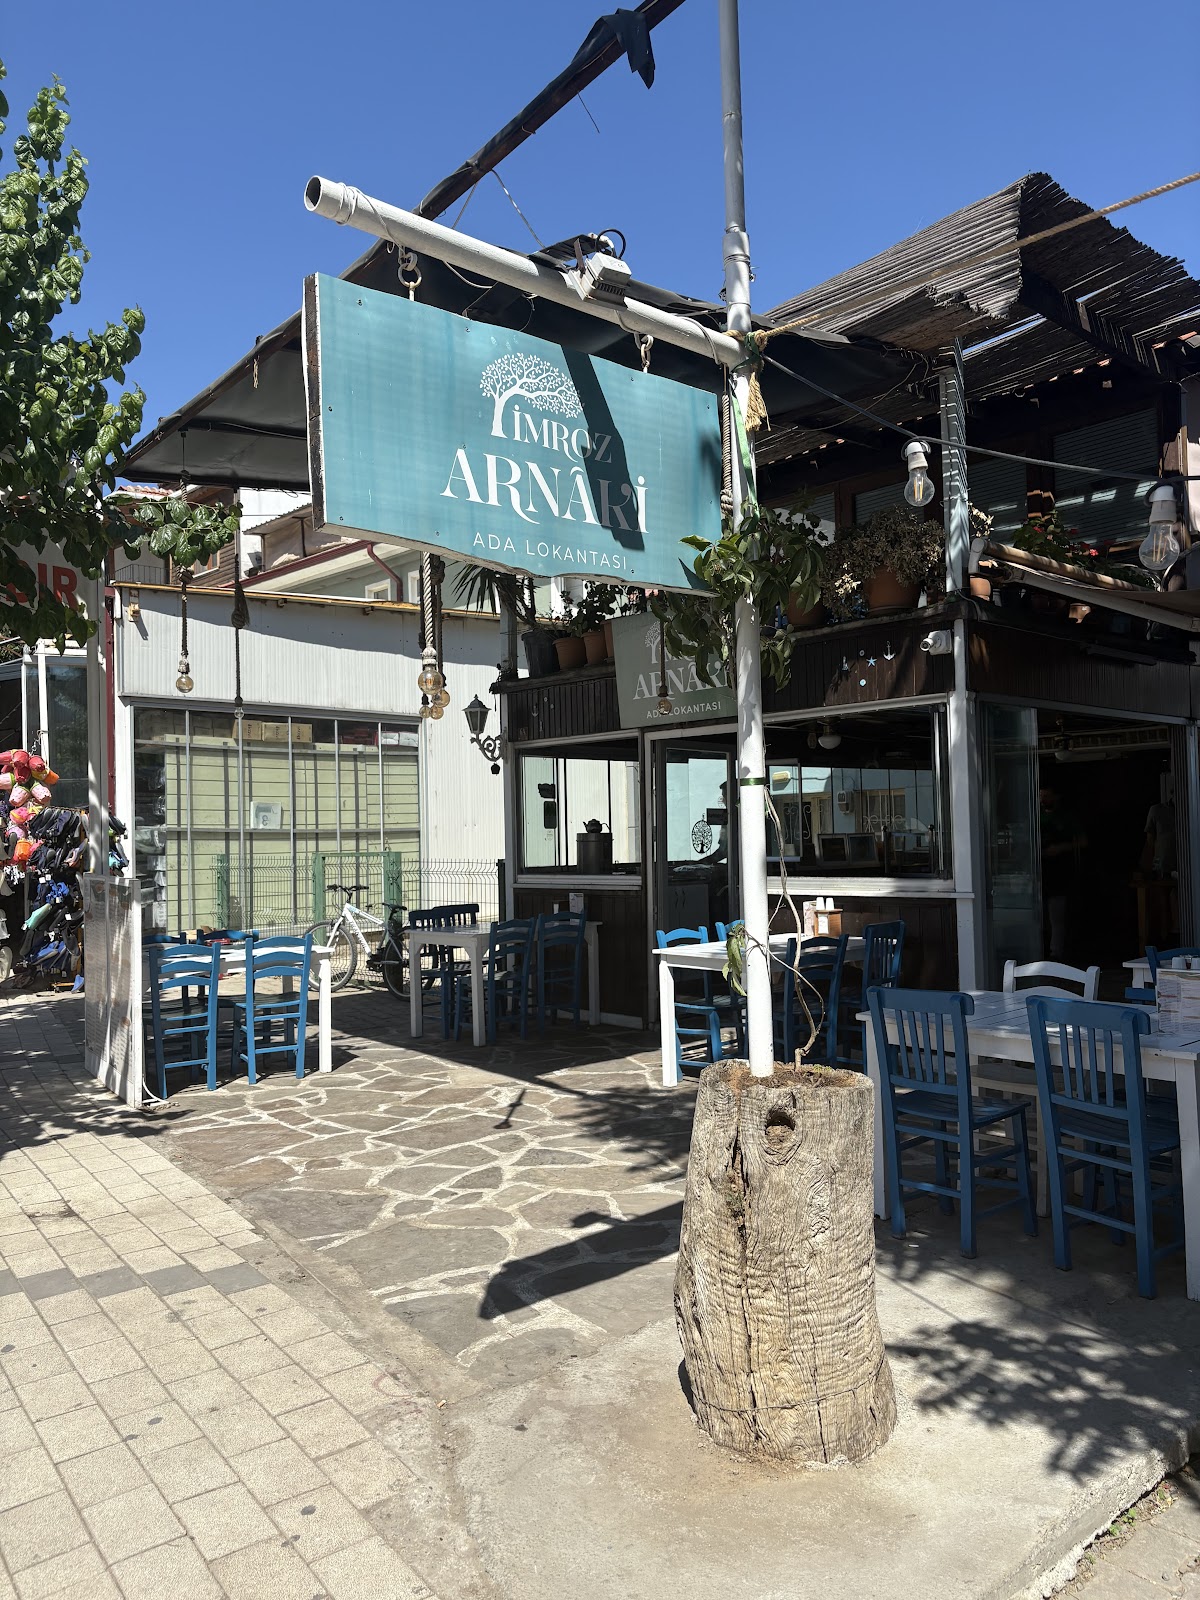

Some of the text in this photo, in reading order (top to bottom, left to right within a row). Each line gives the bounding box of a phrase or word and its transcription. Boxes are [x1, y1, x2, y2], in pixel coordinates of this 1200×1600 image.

[512, 404, 612, 463] İMROZ
[473, 532, 627, 570] ADA LOKANTASI
